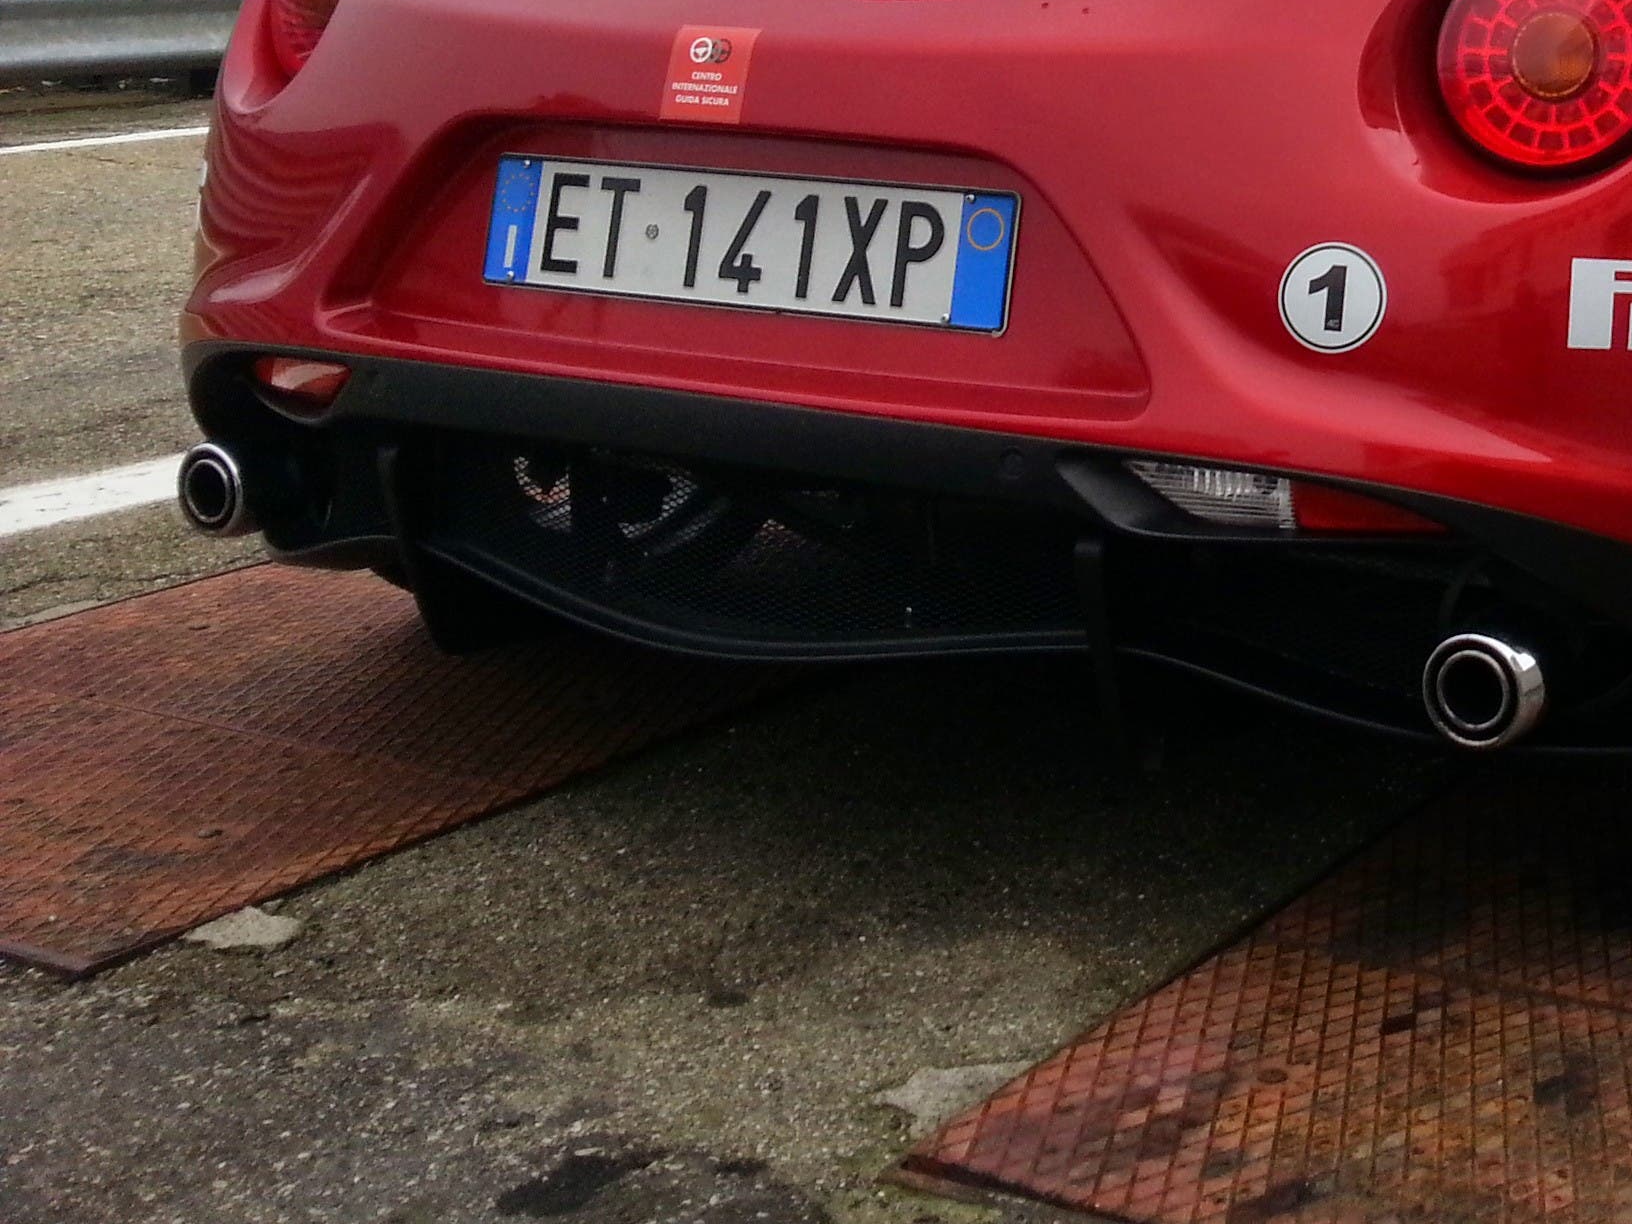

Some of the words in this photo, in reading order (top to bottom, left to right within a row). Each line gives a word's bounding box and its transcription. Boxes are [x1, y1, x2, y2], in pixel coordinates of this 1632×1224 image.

[691, 71, 722, 81] CENTRO
[672, 82, 738, 94] INTERNAZIONALE
[675, 94, 700, 104] GUIDA
[701, 96, 729, 106] SICURA
[541, 173, 642, 278] ET
[682, 185, 946, 308] 141XP
[1308, 265, 1347, 332] 1
